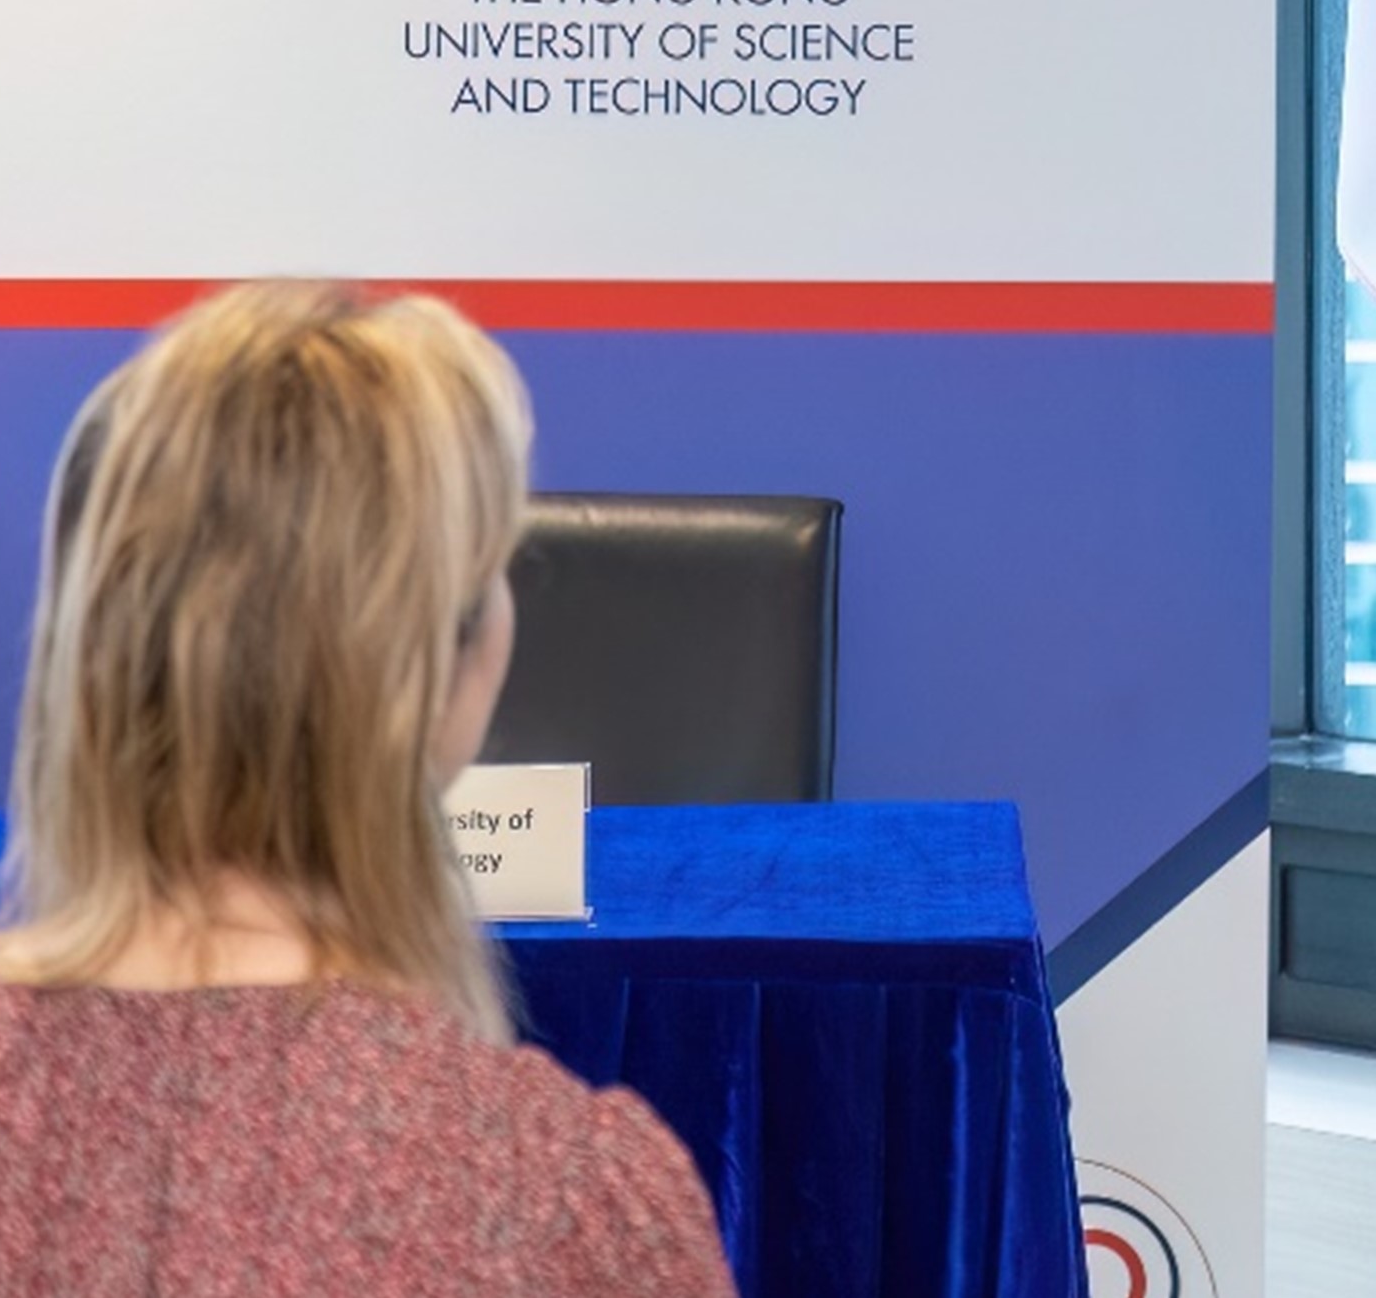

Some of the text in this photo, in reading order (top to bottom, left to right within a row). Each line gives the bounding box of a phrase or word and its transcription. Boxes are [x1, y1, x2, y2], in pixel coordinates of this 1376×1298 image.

[405, 22, 913, 61] UNIVERSITY OF SCIENCE
[451, 78, 866, 115] AND TECHNOLOGY
[447, 808, 534, 835] rsity of
